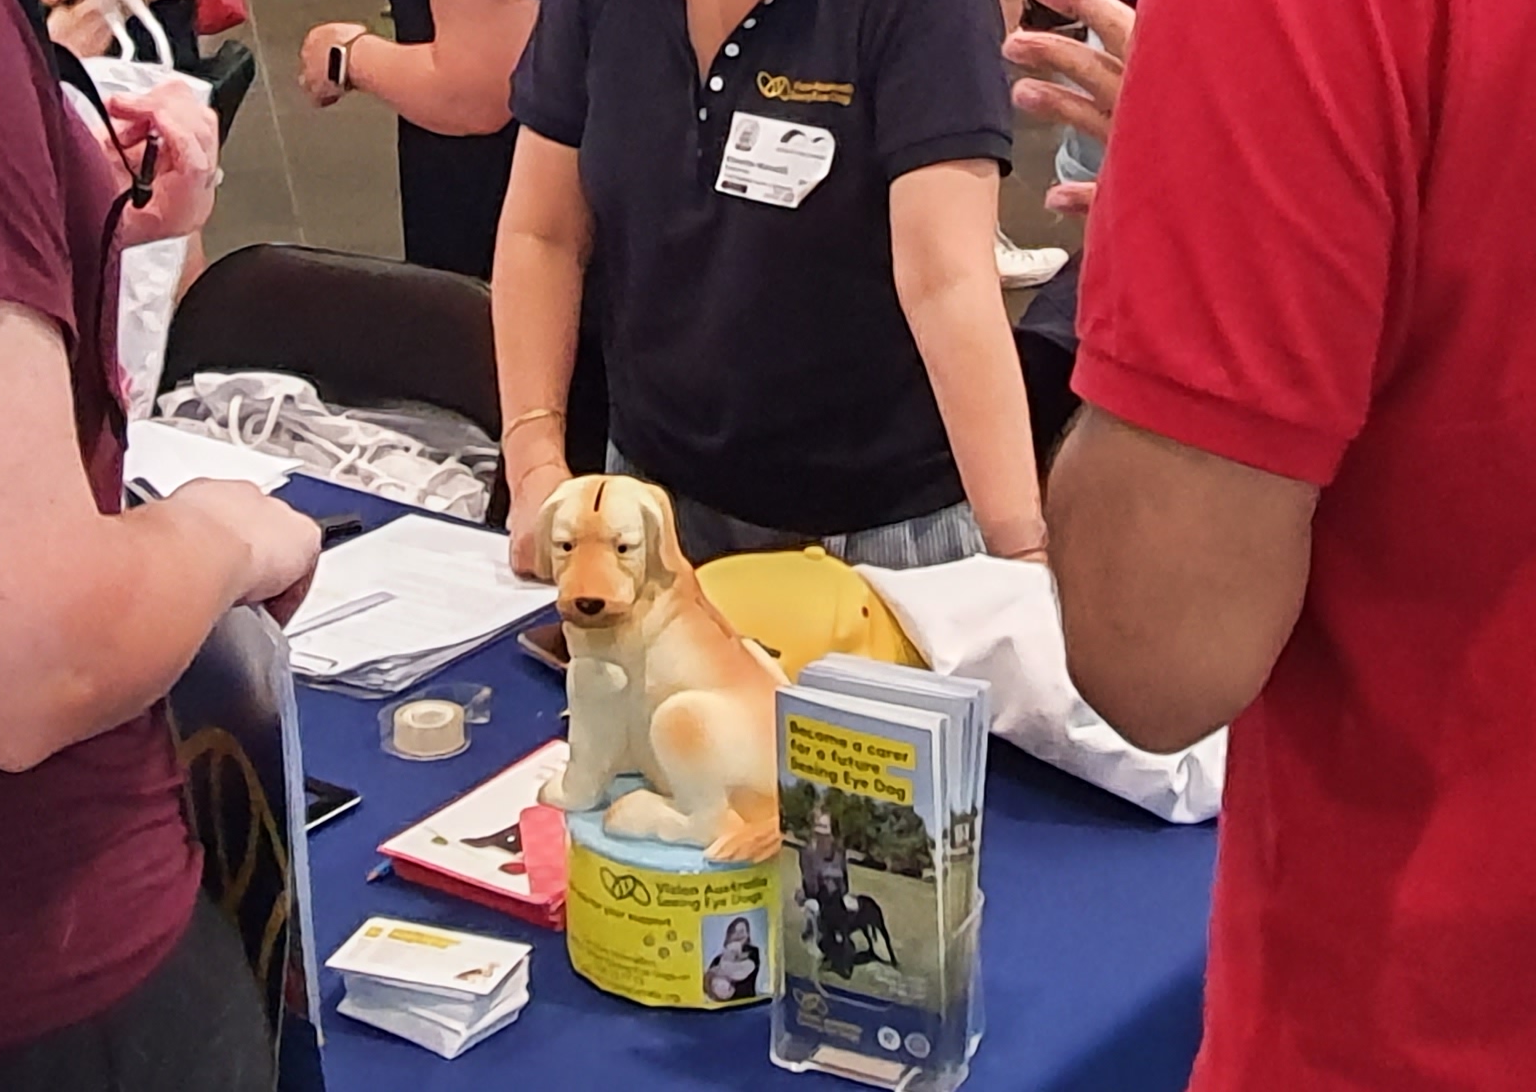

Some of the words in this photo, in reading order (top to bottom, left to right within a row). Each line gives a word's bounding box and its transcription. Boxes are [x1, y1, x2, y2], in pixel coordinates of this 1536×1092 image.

[789, 720, 848, 749] Become
[853, 741, 862, 753] a
[831, 749, 880, 775] future
[874, 778, 906, 802] Dog
